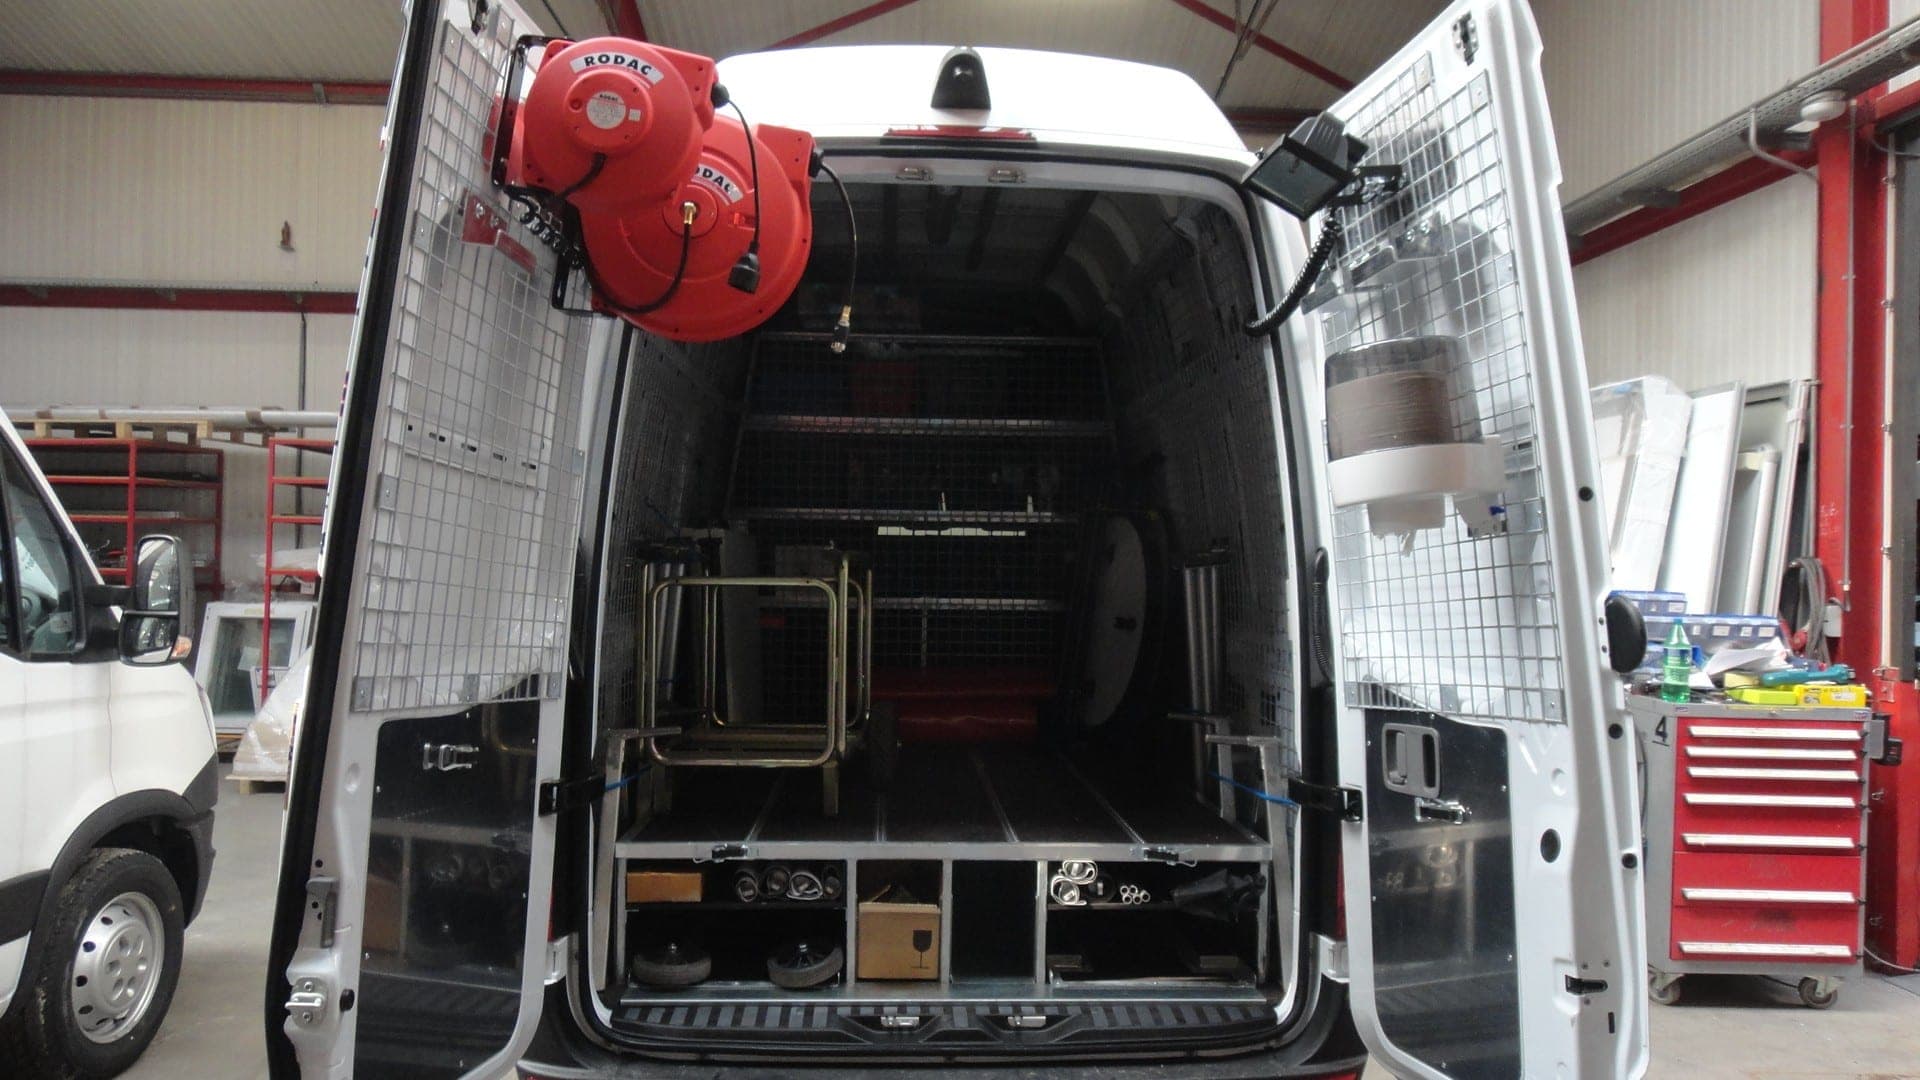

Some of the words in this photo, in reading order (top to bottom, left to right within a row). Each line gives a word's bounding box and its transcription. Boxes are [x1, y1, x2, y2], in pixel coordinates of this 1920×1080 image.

[584, 54, 652, 75] RODAC
[695, 166, 731, 192] DAC
[1655, 715, 1668, 742] 4
